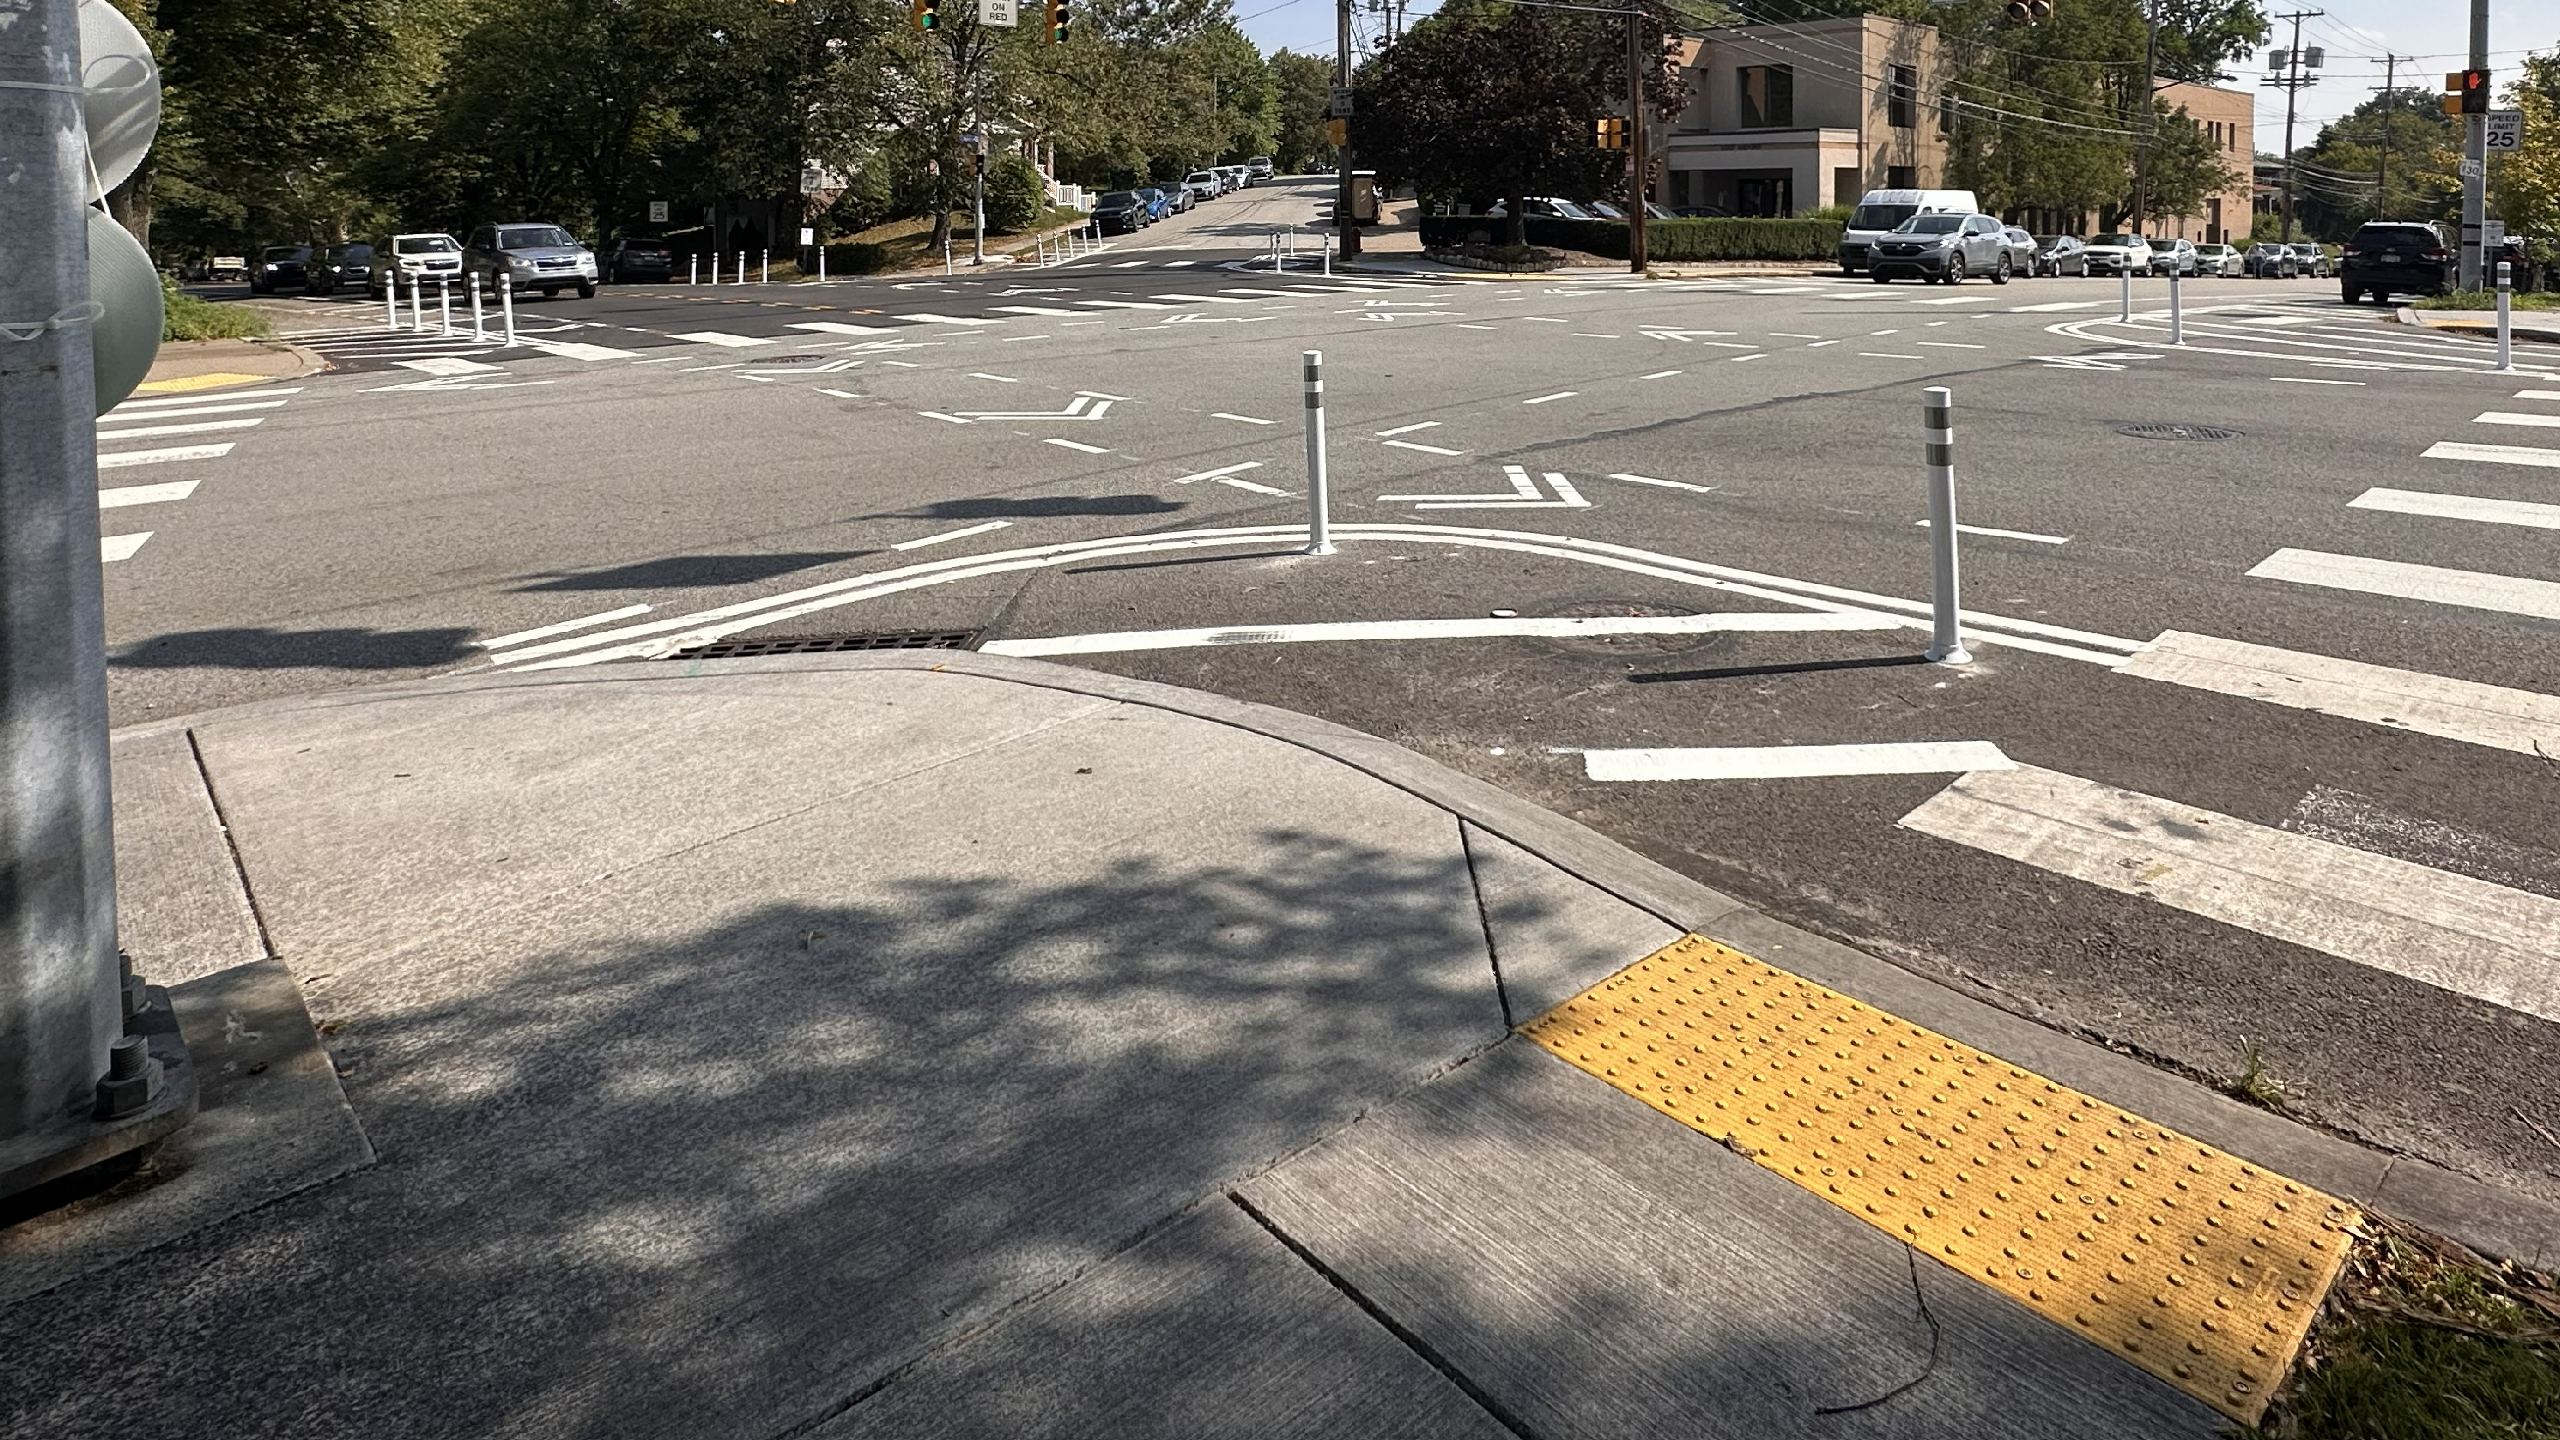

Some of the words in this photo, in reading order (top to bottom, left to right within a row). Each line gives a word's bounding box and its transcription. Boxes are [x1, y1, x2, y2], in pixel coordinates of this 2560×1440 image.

[992, 3, 1005, 11] ON
[989, 12, 1008, 21] RED
[2488, 122, 2515, 130] LIMIT
[2487, 131, 2515, 147] 25
